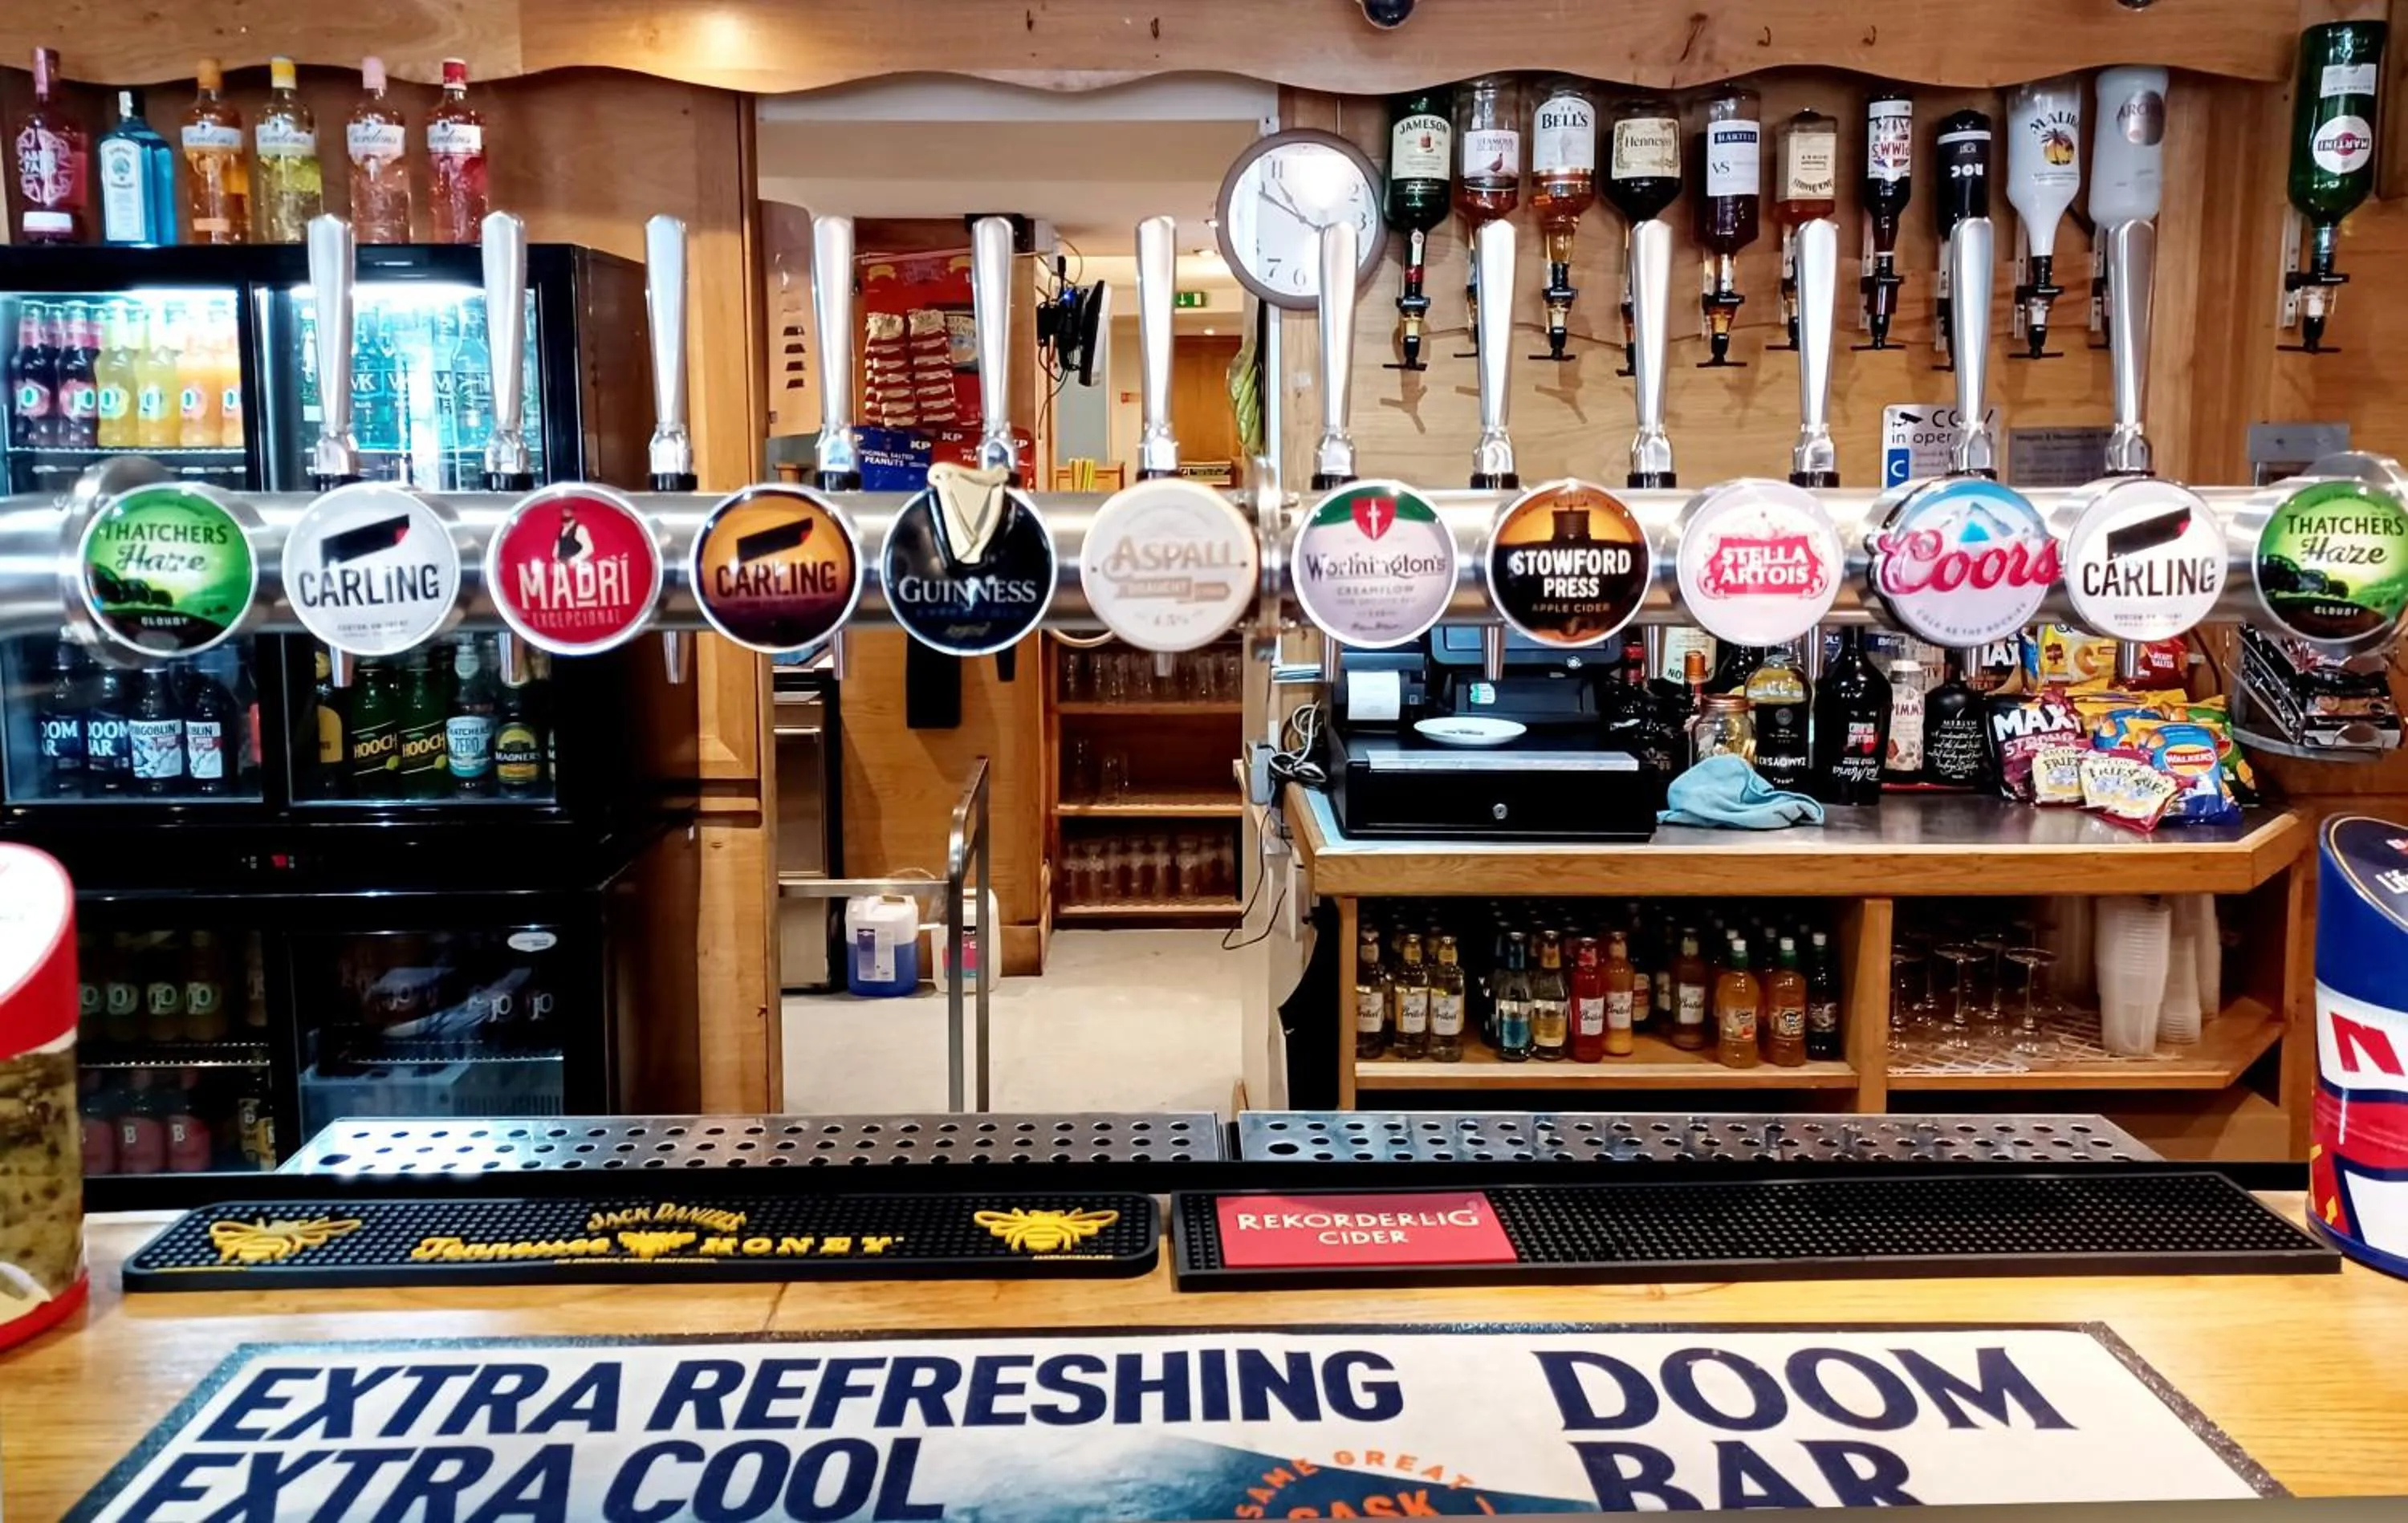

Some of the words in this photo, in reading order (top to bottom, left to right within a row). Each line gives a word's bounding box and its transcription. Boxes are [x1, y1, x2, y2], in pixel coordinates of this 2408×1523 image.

[1399, 119, 1448, 135] JAMESON
[1542, 111, 1588, 129] BELL'S
[2317, 137, 2369, 152] MARTINI
[1711, 162, 1731, 174] VS
[1267, 258, 1282, 278] 7
[909, 440, 932, 450] KP
[1891, 428, 1906, 444] in
[864, 456, 905, 468] PEANUTS
[104, 519, 229, 546] THATCHERS
[2285, 513, 2405, 538] THATCHERS
[116, 542, 209, 575] Haze
[1106, 534, 1236, 573] ASPALL
[1511, 548, 1633, 577] STOWFORD
[1720, 546, 1808, 567] STELLA
[1877, 527, 2064, 595] Coors
[2300, 536, 2390, 566] Haze
[299, 563, 441, 609] CARLING
[715, 560, 838, 599] CARLING
[1543, 577, 1601, 599] PRESS
[1719, 565, 1809, 586] ARTOIS
[2083, 556, 2217, 597] CARLING
[898, 574, 1037, 604] GUINNESS
[531, 607, 623, 629] EXCEPCIONAL
[1531, 603, 1570, 614] APPLE
[1573, 603, 1611, 614] CIDER
[1993, 704, 2075, 742] MAX
[353, 733, 398, 758] HOOCH
[401, 733, 445, 757] HOOCH
[2166, 751, 2216, 763] WALKERS
[586, 1208, 651, 1232] JACK
[1236, 1208, 1479, 1232] REKORDERLIG
[410, 1235, 612, 1261] Tennessee
[698, 1234, 893, 1257] HONEY
[1318, 1229, 1410, 1246] CIDER
[195, 1358, 623, 1442] EXTRA
[645, 1350, 1405, 1432] REFRESHING
[1531, 1346, 2079, 1432] DOOM
[115, 1444, 555, 1523] EXTRA
[599, 1436, 945, 1523] COOL
[1234, 1456, 1320, 1519] SAME
[1332, 1449, 1475, 1491] GREAT
[1566, 1440, 1929, 1513] BAR
